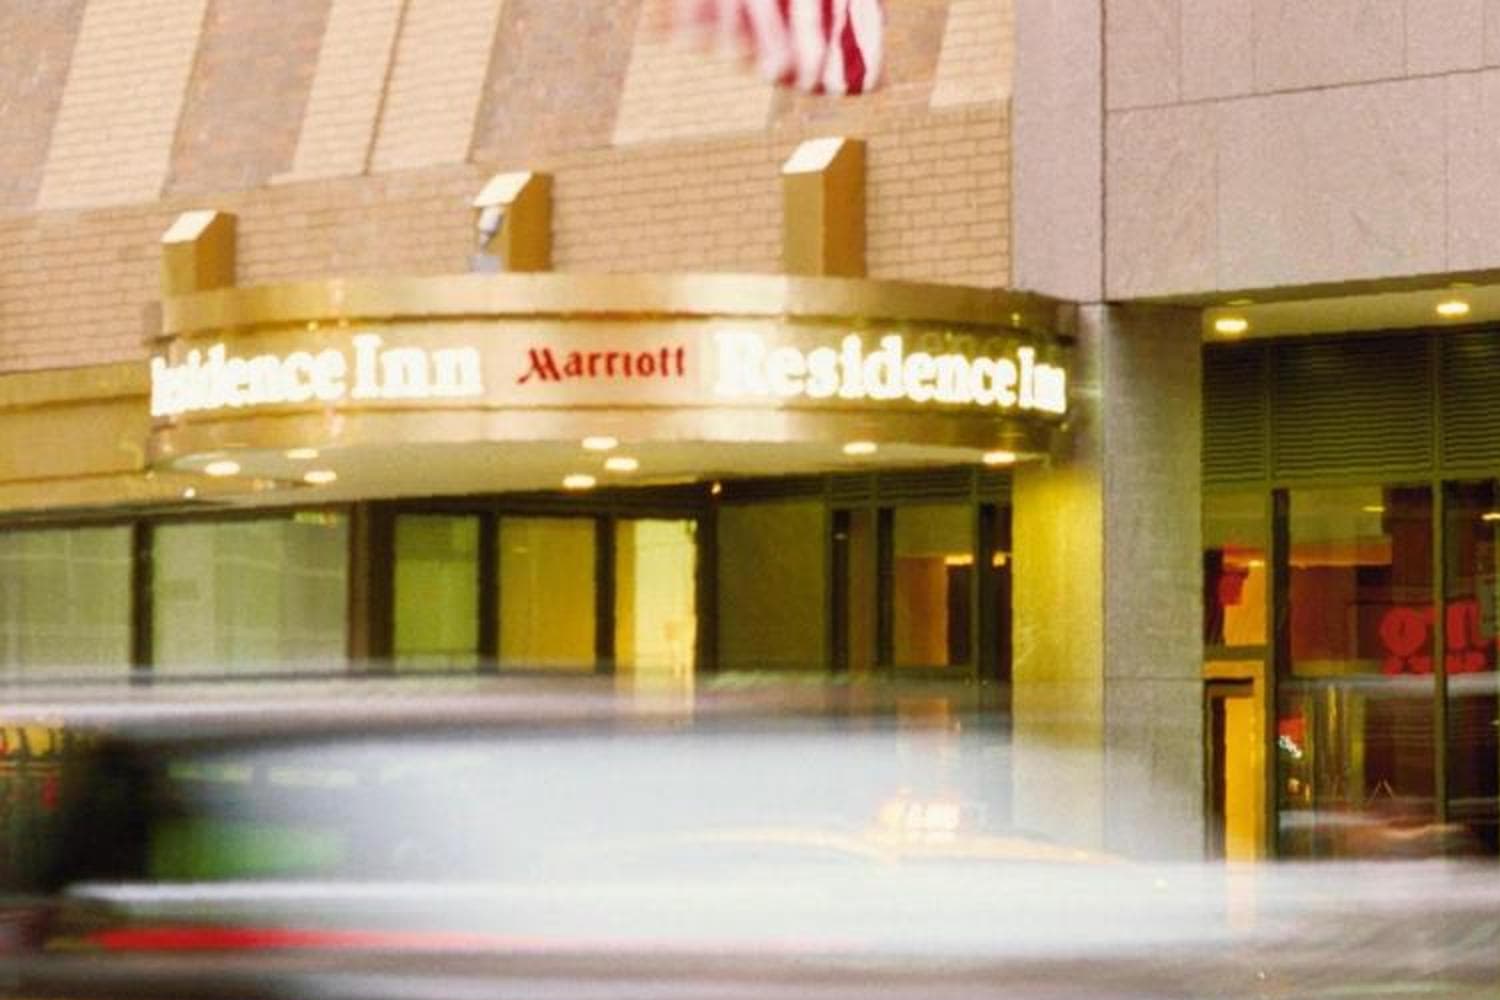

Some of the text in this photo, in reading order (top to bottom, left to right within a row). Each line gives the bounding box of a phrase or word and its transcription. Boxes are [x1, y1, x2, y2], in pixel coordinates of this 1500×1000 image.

[351, 334, 484, 399] Inn
[518, 347, 686, 384] Marriott
[713, 332, 1014, 404] Residence
